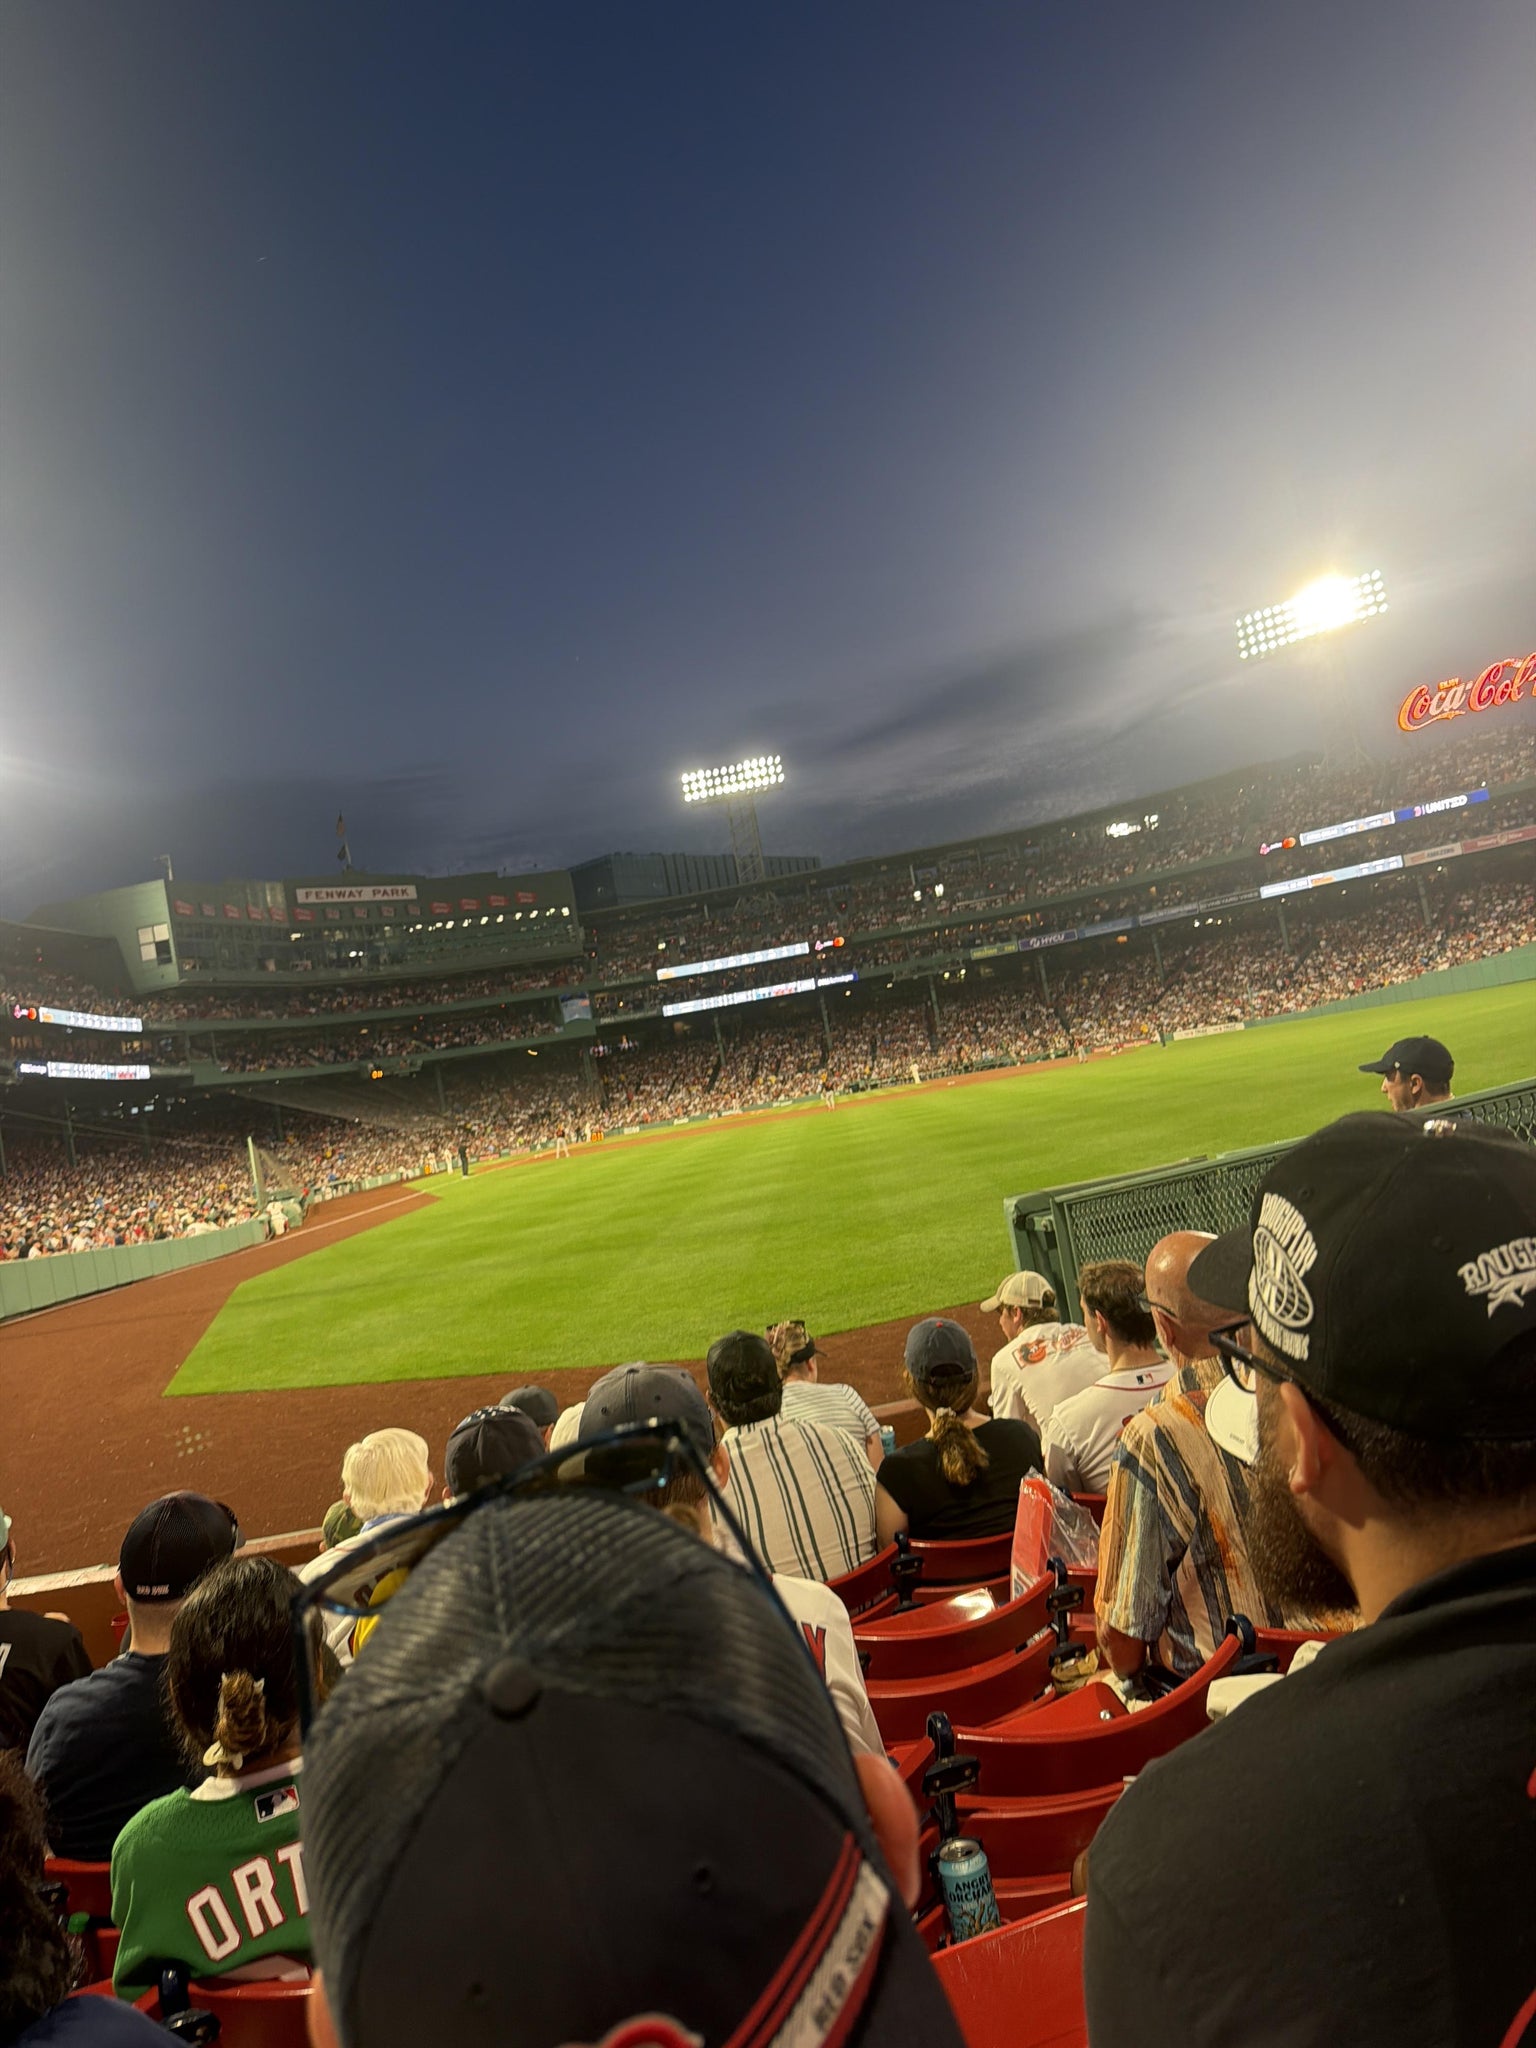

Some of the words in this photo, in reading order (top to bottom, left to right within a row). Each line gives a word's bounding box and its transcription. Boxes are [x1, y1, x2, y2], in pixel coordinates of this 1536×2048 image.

[1397, 652, 1536, 731] Coca-Col
[1425, 795, 1468, 814] UNITED
[304, 889, 363, 901] FENWAY
[372, 887, 409, 900] PARK
[955, 1872, 990, 1893] ANGRY
